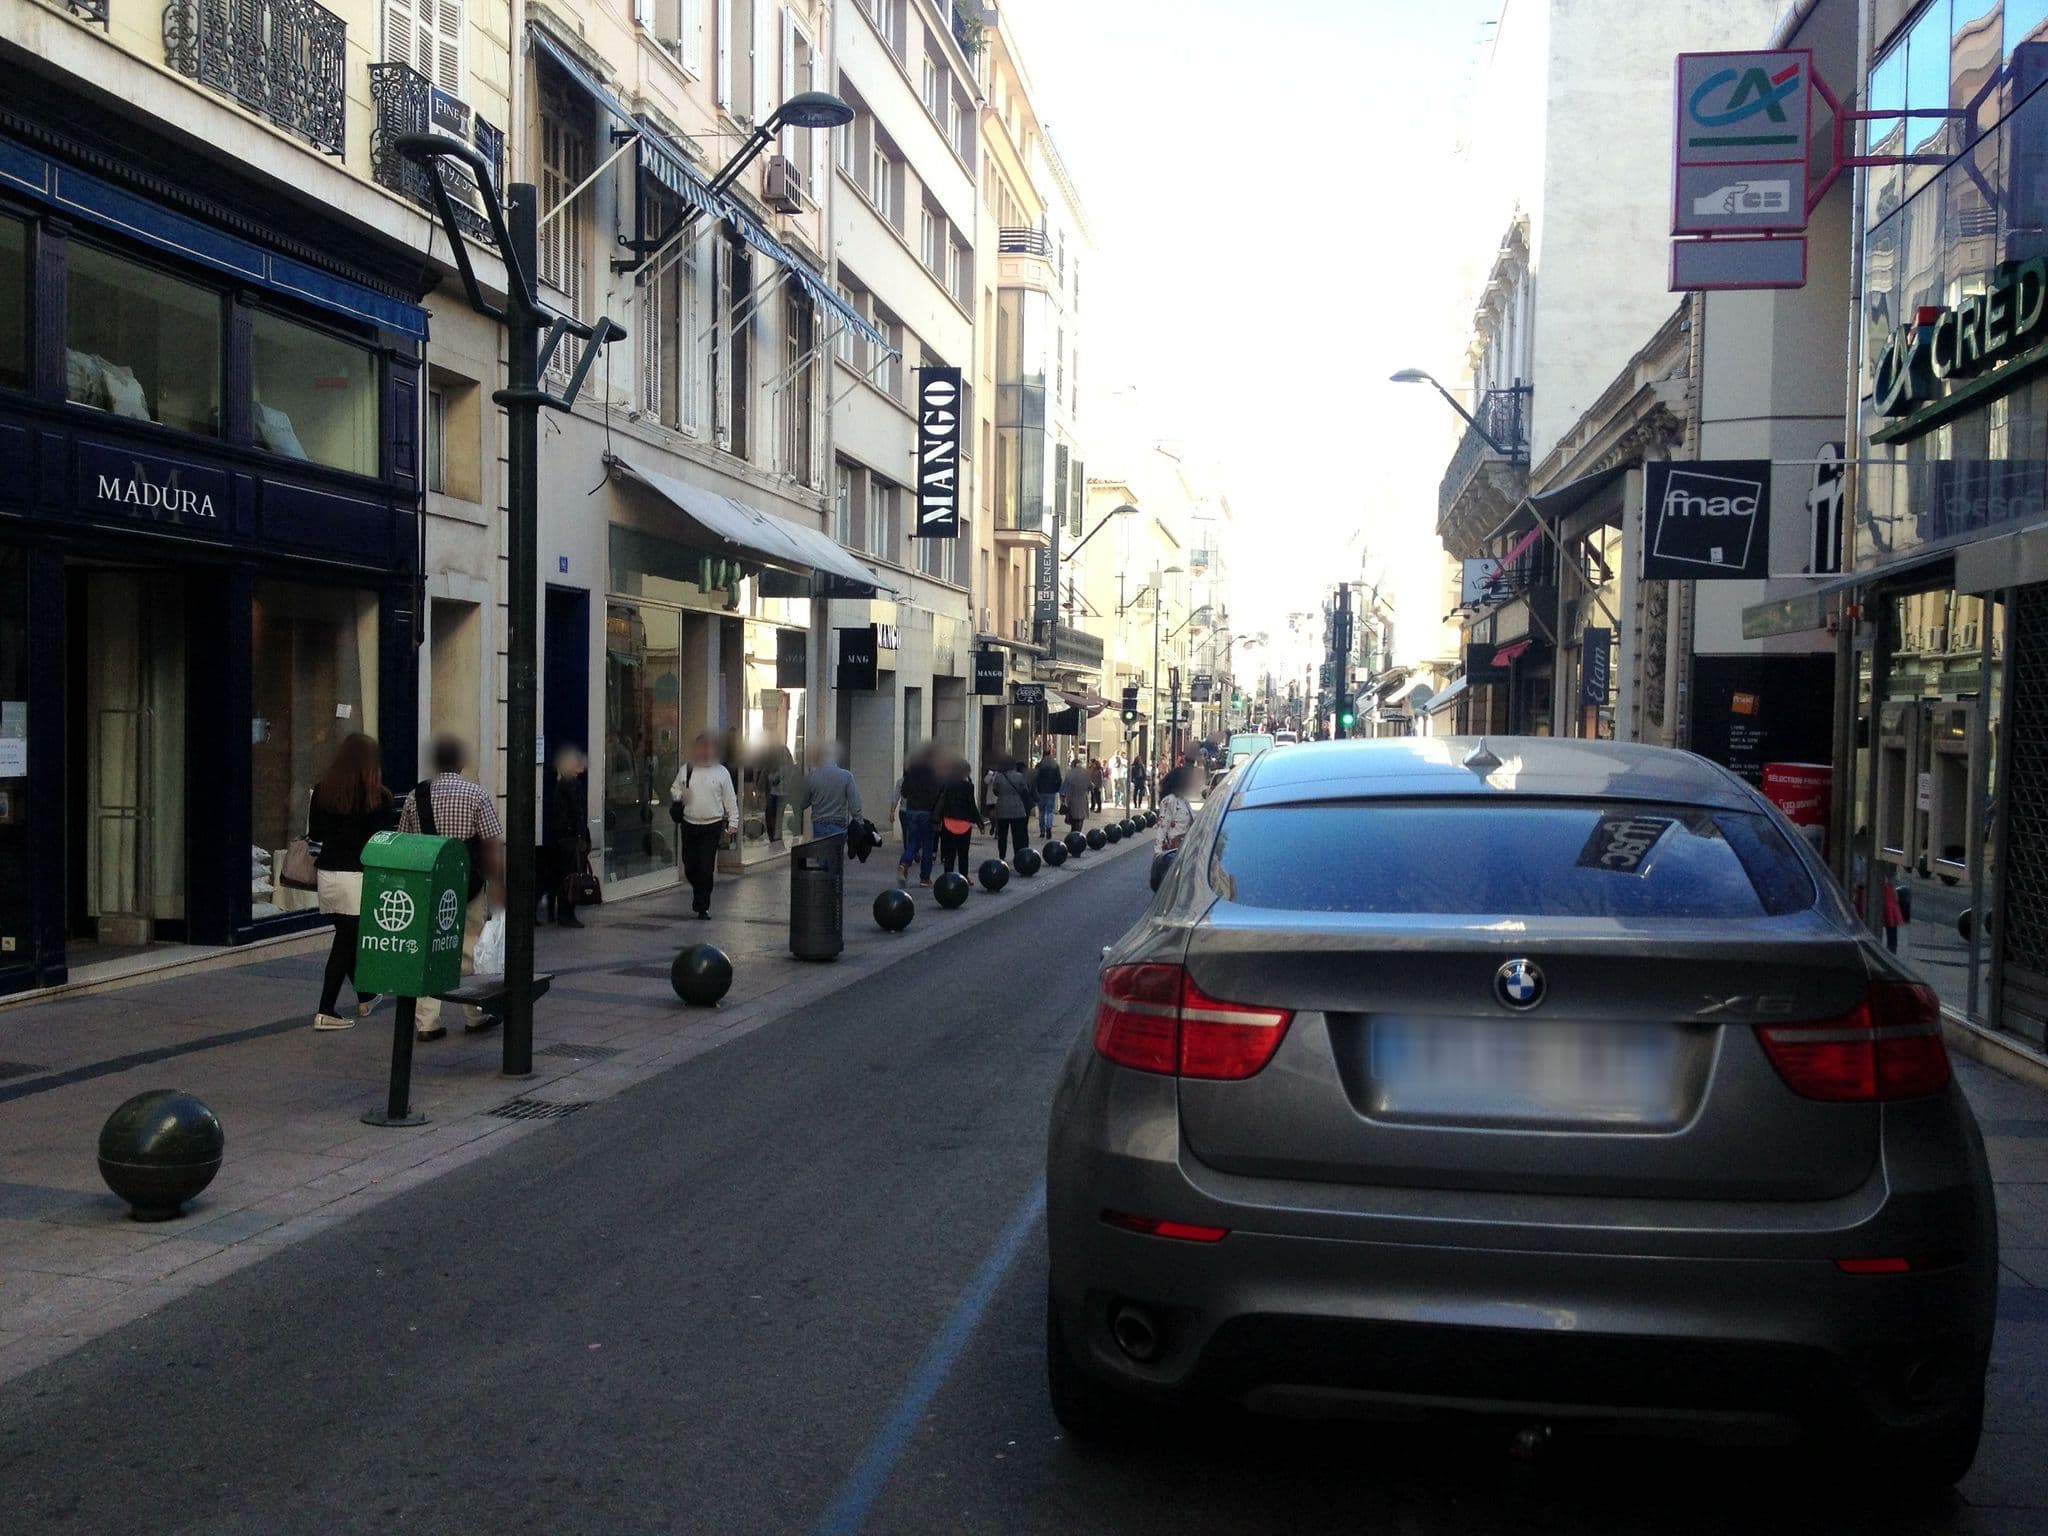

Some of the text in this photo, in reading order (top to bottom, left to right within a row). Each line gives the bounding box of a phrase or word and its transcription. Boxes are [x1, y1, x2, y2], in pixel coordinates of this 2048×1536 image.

[435, 97, 460, 120] FINE
[922, 380, 956, 524] MANGO
[96, 474, 217, 518] MADURA
[1664, 489, 1758, 517] fnac
[847, 654, 870, 665] MNG
[976, 669, 1004, 678] MANGO
[1586, 646, 1607, 703] Etam
